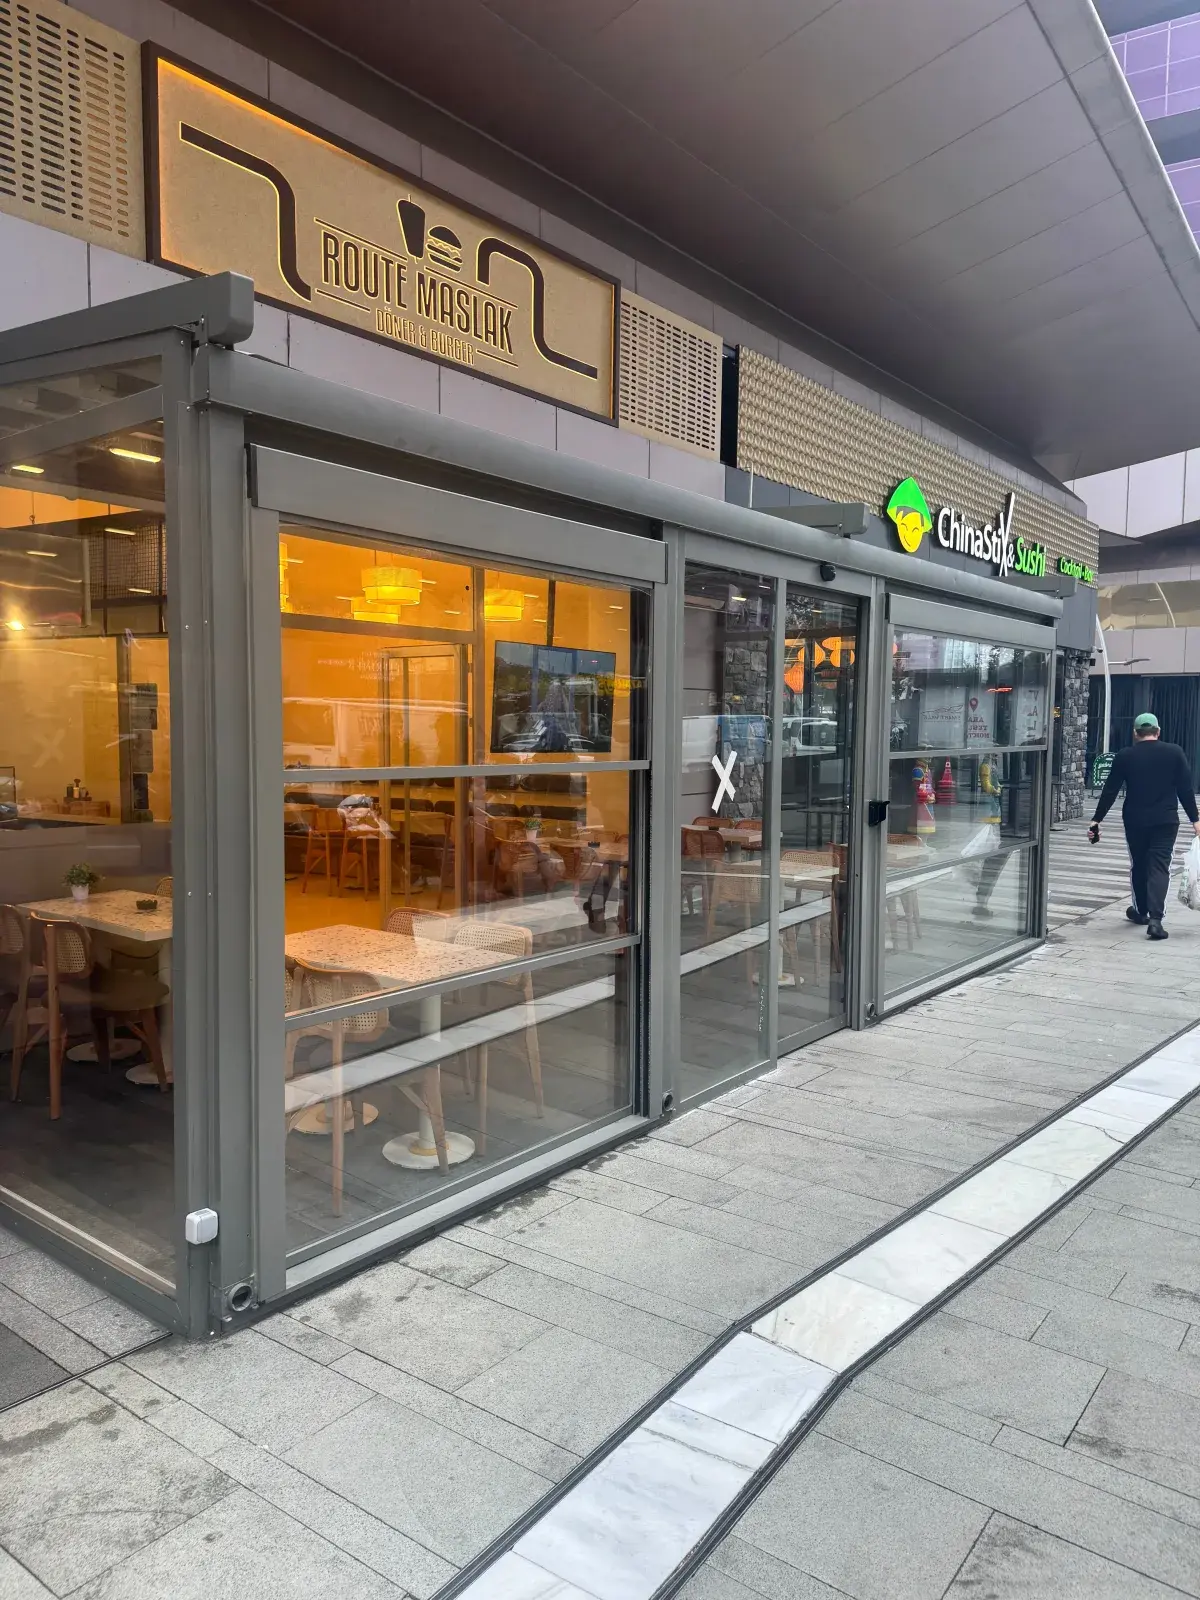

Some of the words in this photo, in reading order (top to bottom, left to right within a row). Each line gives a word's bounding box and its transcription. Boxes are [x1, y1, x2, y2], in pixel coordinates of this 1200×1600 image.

[321, 229, 408, 310] ROUTE
[416, 270, 514, 356] MASLAK
[375, 306, 417, 345] DÖNER
[419, 324, 428, 348] &
[429, 328, 475, 366] BURGER
[1007, 543, 1015, 569] &
[1015, 536, 1047, 577] Sushi
